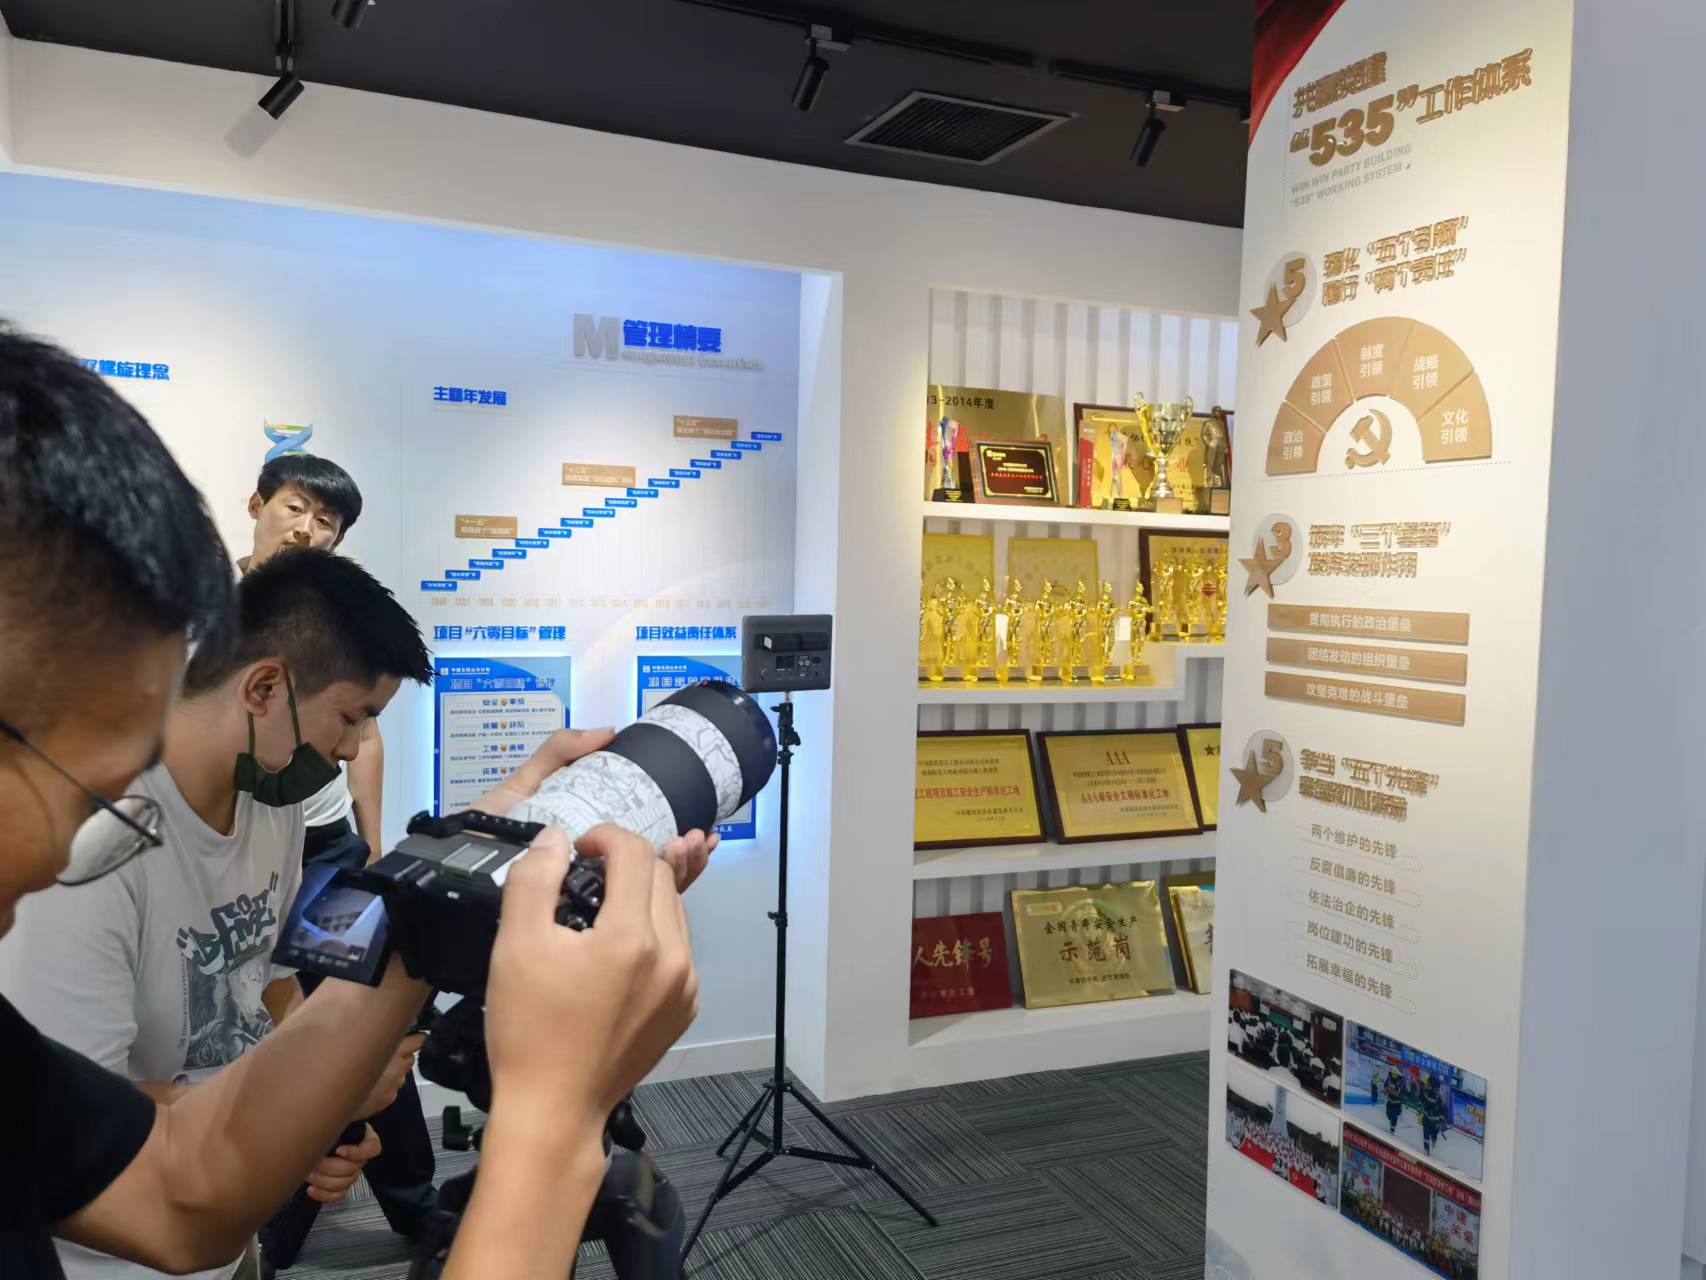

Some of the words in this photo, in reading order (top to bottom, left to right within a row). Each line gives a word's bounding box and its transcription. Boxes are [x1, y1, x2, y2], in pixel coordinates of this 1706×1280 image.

[1291, 170, 1330, 195] WIN-WIN
[1331, 163, 1361, 180] PARTY
[1363, 143, 1413, 168] BUILDING
[1316, 176, 1361, 199] WORKING
[1363, 161, 1403, 183] SYSTEM
[1282, 257, 1305, 296] 5
[433, 386, 507, 406] 主题年发展
[1269, 522, 1292, 560] 3
[1105, 751, 1130, 766] AAA
[1260, 739, 1283, 776] 5
[1311, 823, 1397, 859] 两个维护的先锋
[1310, 856, 1396, 895] 反腐倡廉的先锋
[1308, 888, 1395, 930] 依法治企的先锋
[1060, 933, 1131, 961] 示范岗
[1307, 920, 1394, 963] 岗位建功的先锋
[1306, 953, 1393, 999] 拓展幸福的先锋
